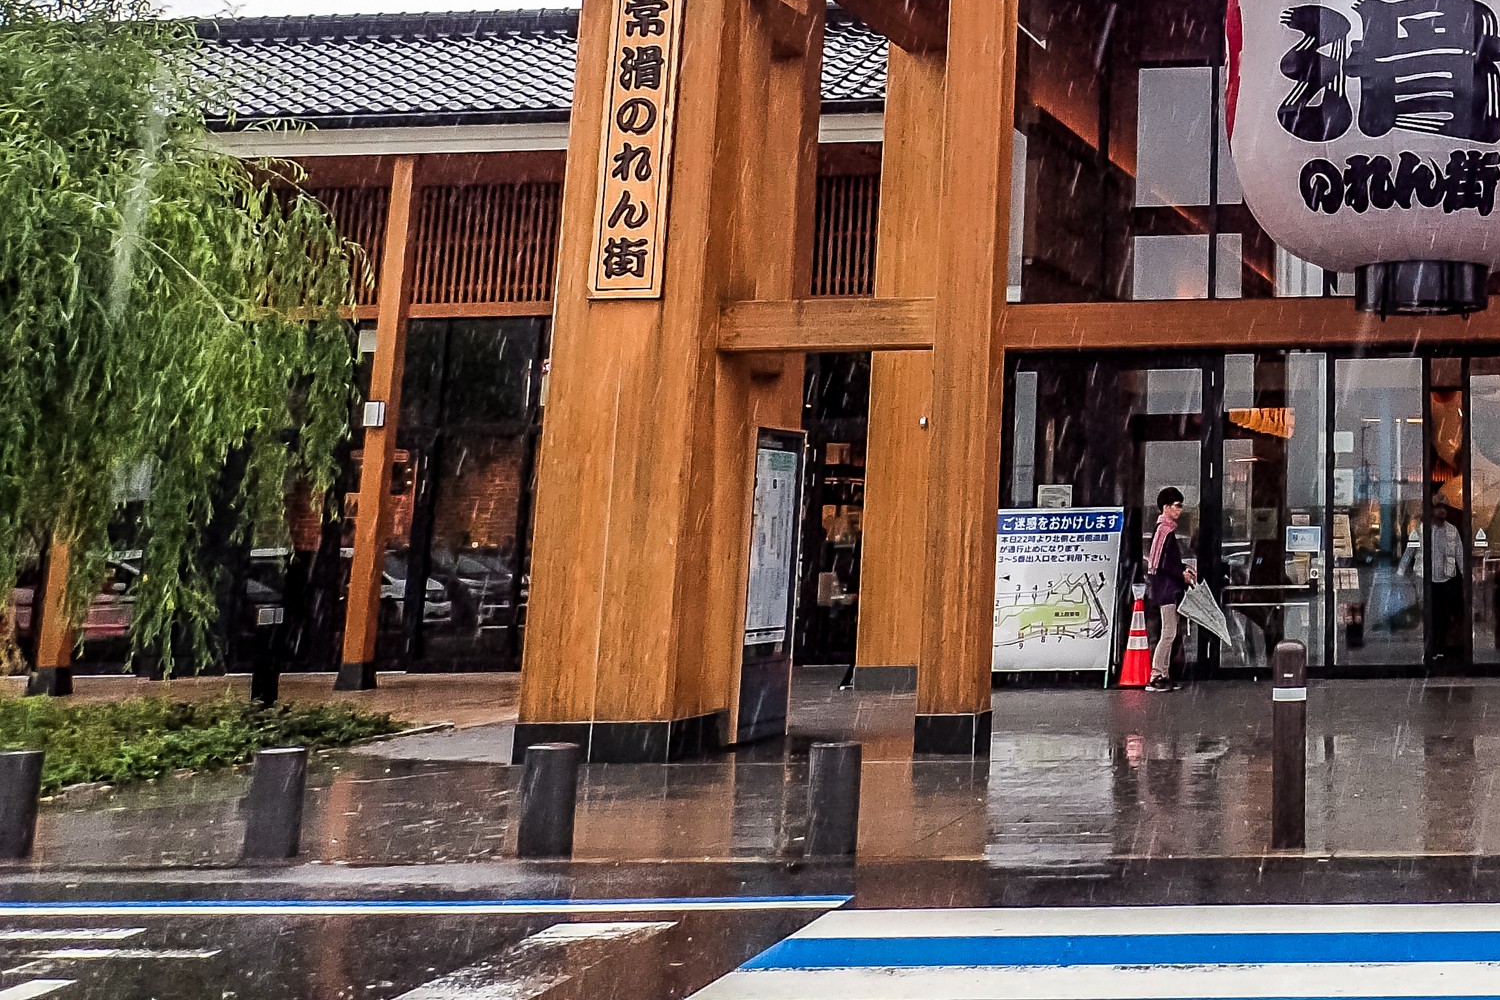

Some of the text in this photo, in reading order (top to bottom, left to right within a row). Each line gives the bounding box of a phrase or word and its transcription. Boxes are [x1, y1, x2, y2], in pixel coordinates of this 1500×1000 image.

[1002, 515, 1119, 531] ご迷惑をおかけします
